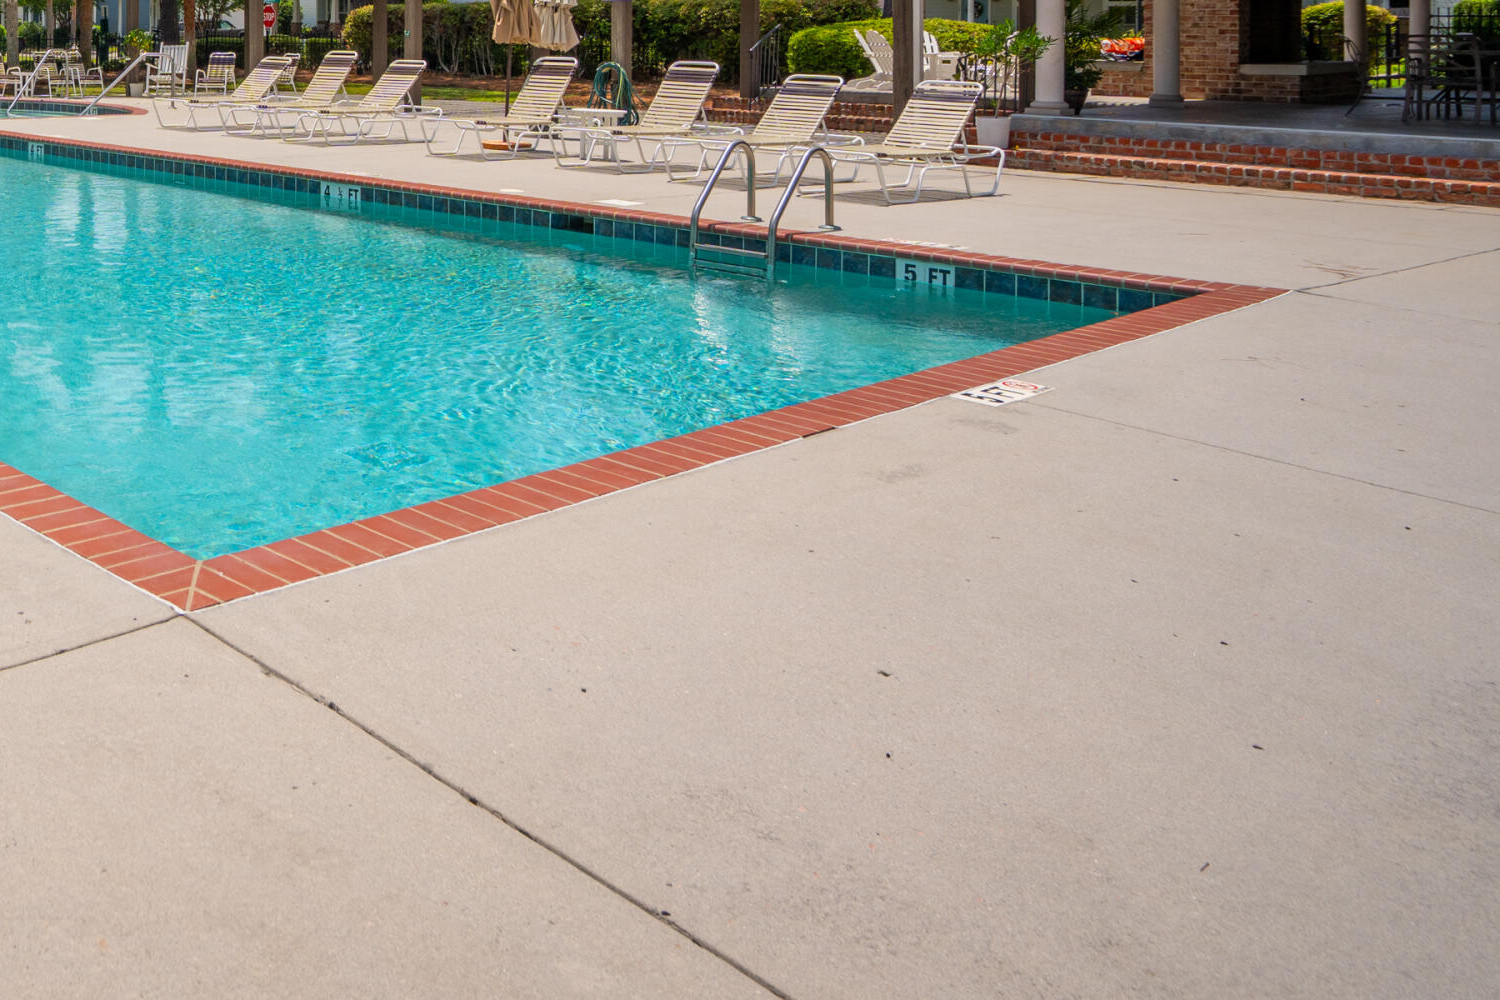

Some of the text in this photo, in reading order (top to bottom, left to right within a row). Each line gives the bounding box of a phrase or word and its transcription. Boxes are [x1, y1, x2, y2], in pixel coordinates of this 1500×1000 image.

[324, 184, 331, 196] 4
[348, 188, 359, 200] FT
[904, 263, 951, 286] 5 FT
[960, 392, 1004, 403] 5
[981, 386, 1025, 399] FT
